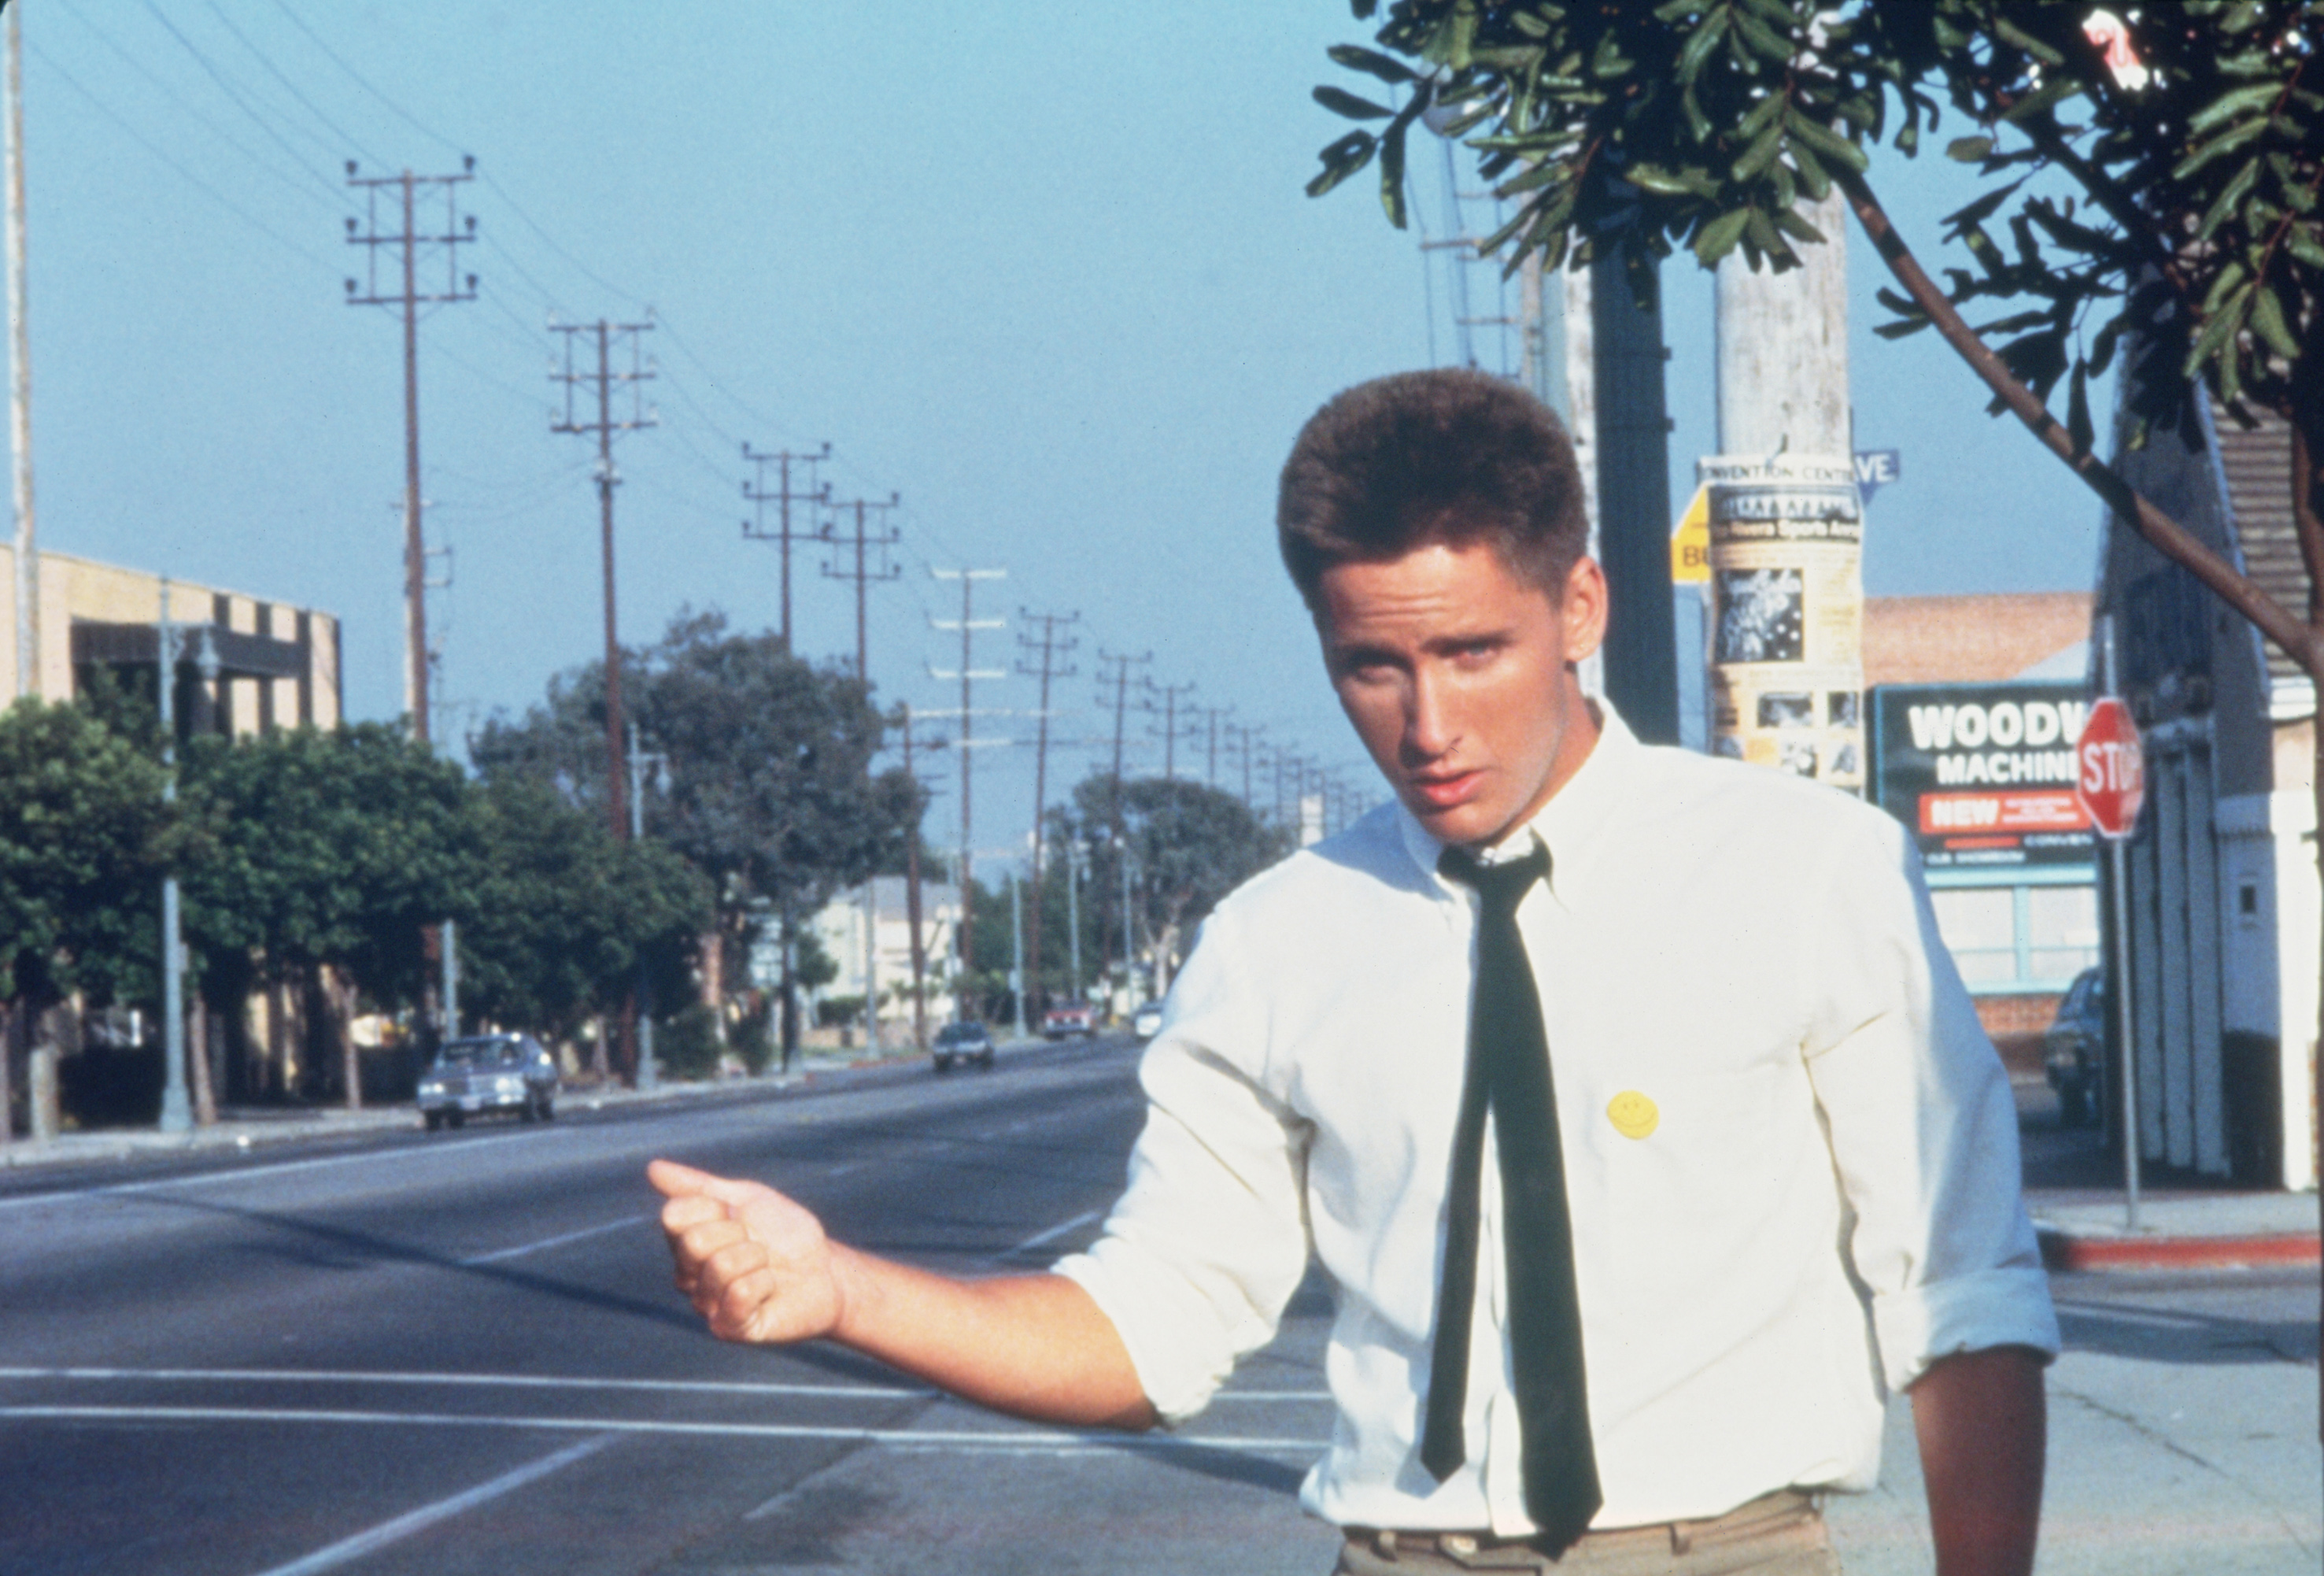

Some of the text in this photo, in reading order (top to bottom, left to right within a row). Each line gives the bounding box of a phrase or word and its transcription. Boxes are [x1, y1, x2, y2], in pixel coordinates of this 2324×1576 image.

[1854, 454, 1894, 483] VE
[2084, 742, 2141, 793] STOP
[1931, 797, 2000, 827] NEW
